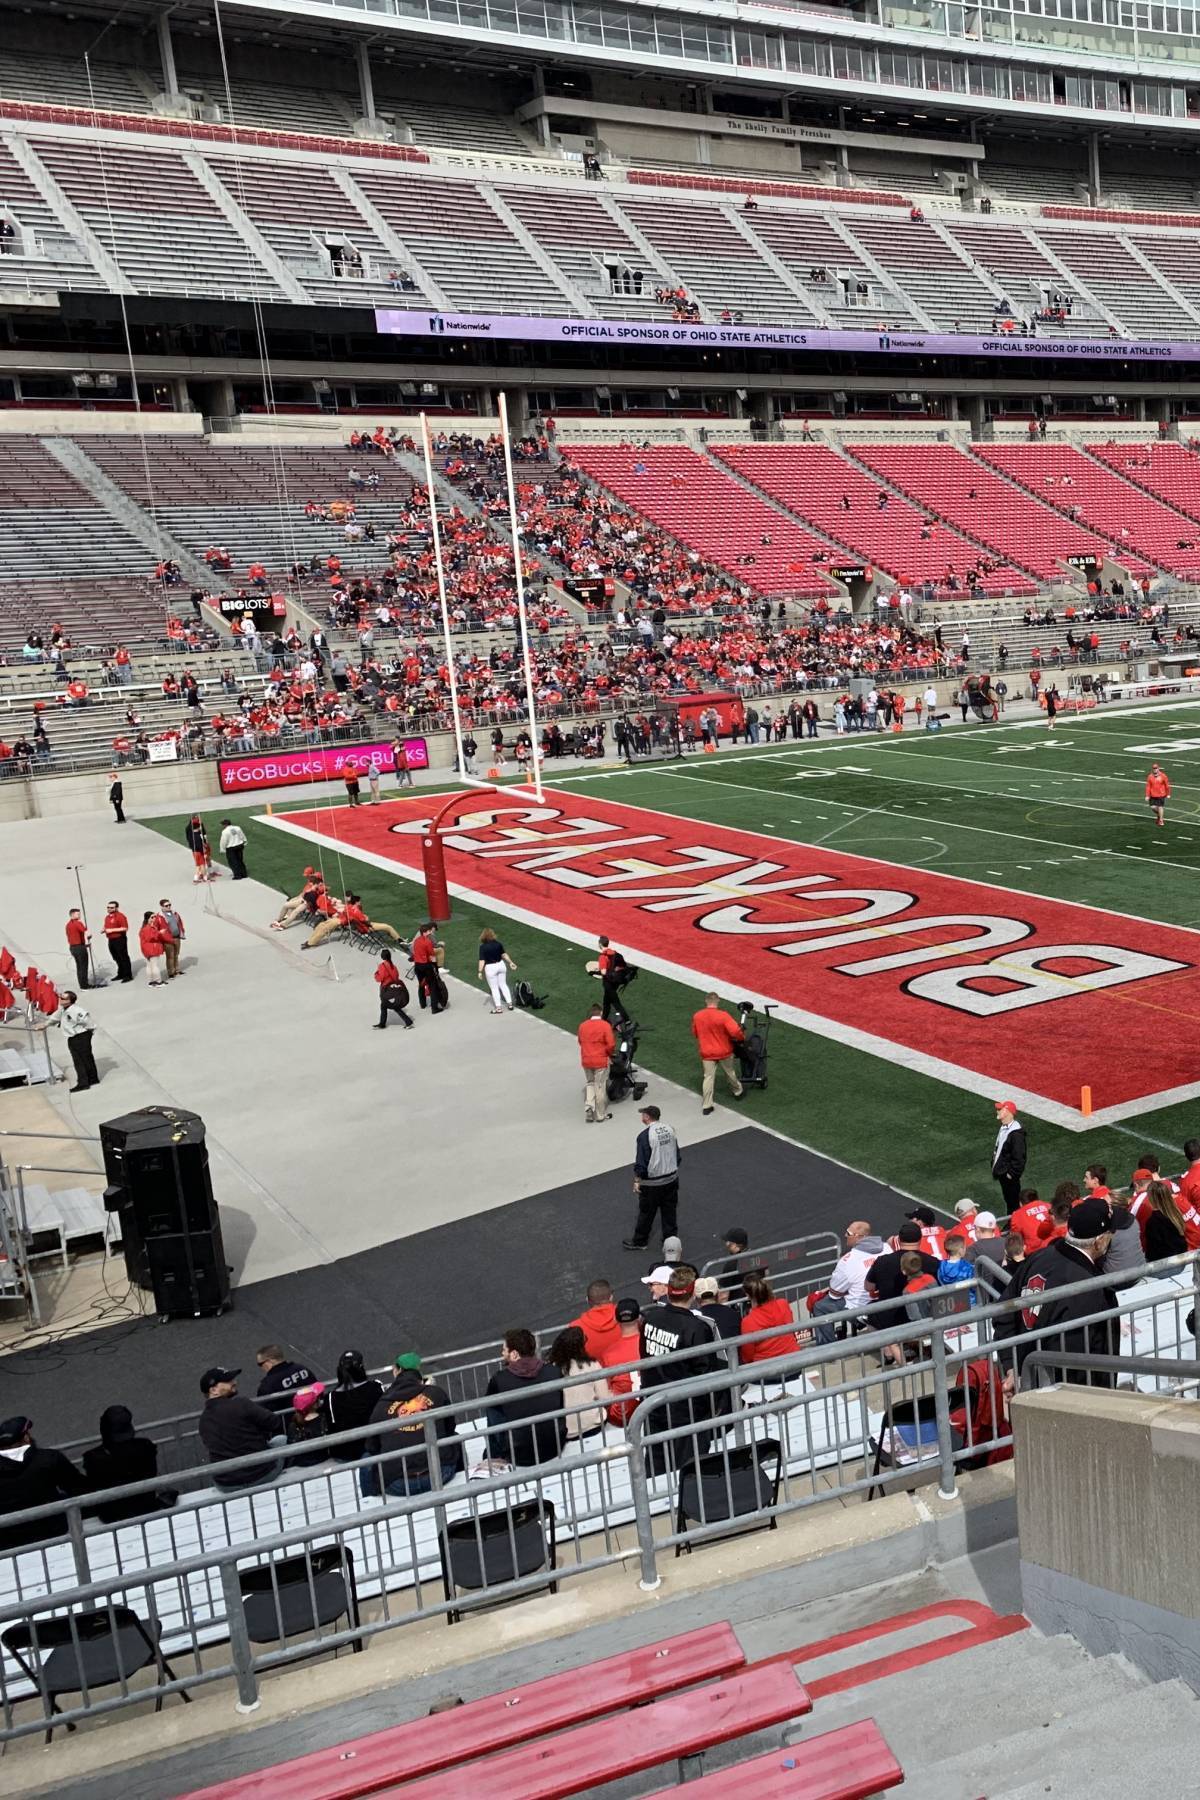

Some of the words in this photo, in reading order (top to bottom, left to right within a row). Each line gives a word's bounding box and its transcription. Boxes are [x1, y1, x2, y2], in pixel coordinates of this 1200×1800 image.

[728, 121, 741, 129] The
[745, 122, 768, 134] Shelly
[772, 126, 796, 136] Family
[447, 321, 489, 331] Nationwide
[562, 325, 614, 337] OFFICIAL
[617, 327, 669, 339] SPONSOR
[673, 330, 687, 340] OF
[690, 331, 717, 341] OHIO
[720, 332, 750, 342] STATE
[753, 333, 807, 344] ATHLETICS
[982, 342, 1022, 351] OFFICIAL
[1024, 344, 1064, 353] SPONSOR
[1067, 345, 1078, 353] OF
[1081, 345, 1101, 354] OHIO
[1104, 346, 1127, 355] STATE
[1130, 347, 1171, 356] ATHLETICS
[388, 804, 1190, 1017] BUCKEYES
[926, 1236, 943, 1261] 1
[644, 1323, 680, 1349] STADIUM
[281, 1369, 309, 1389] CFD
